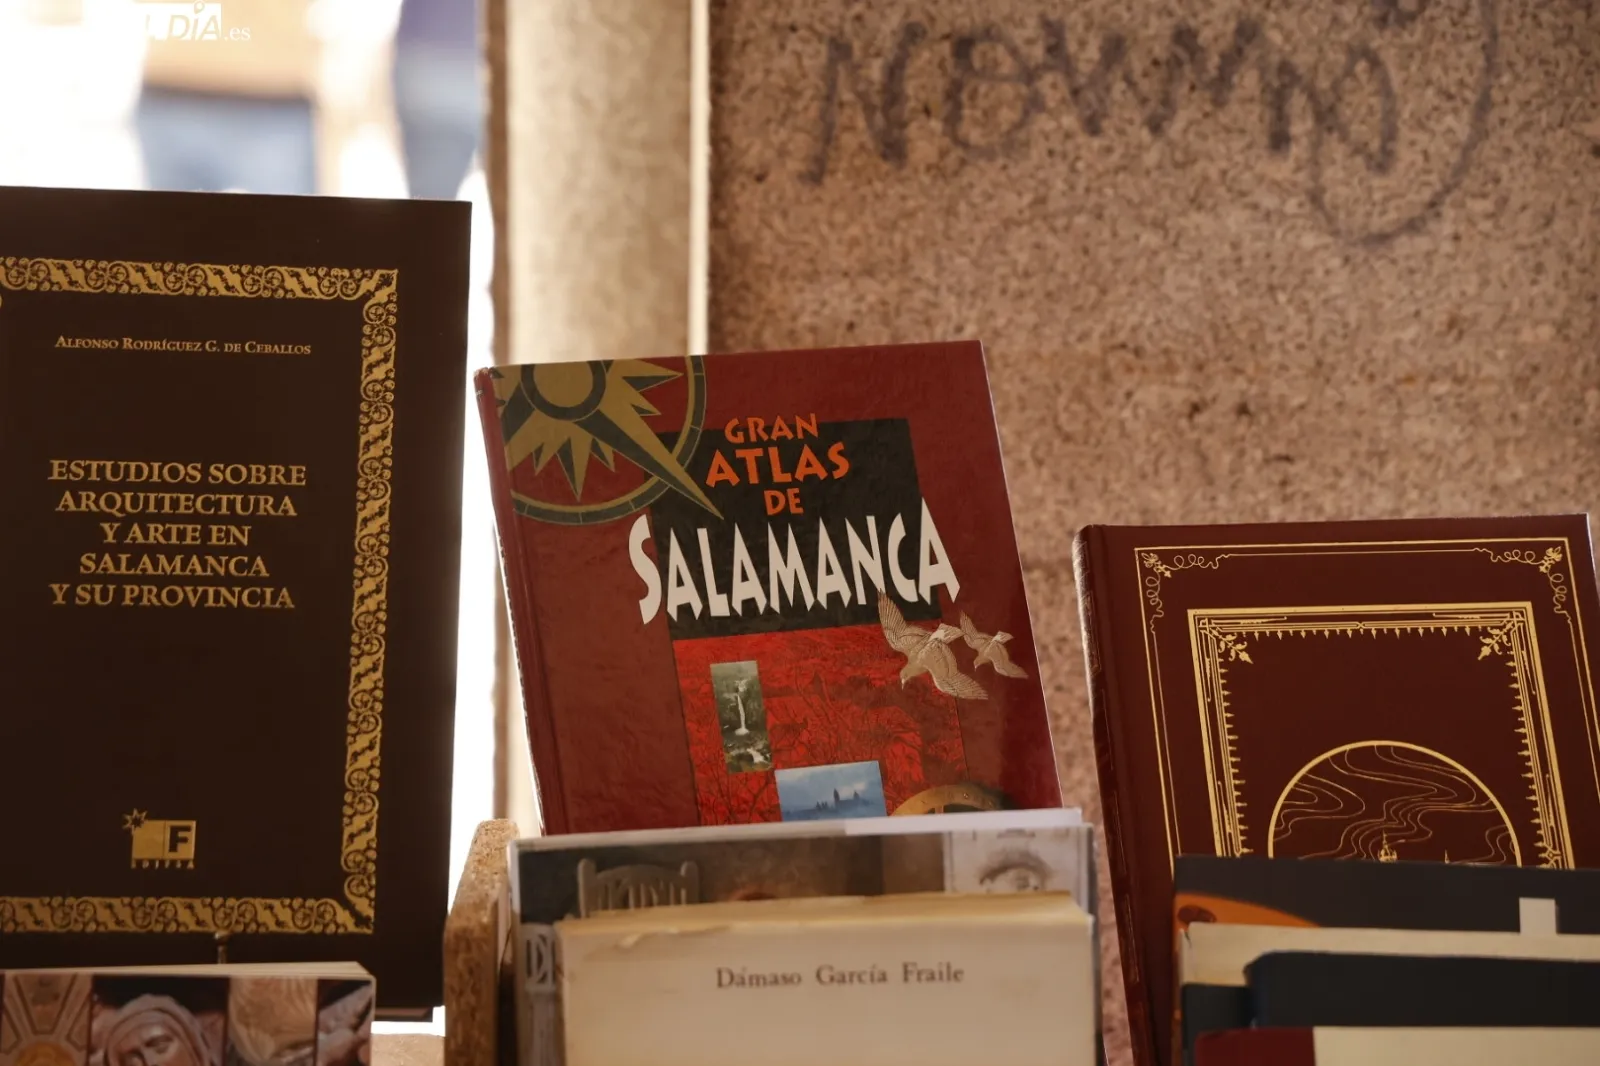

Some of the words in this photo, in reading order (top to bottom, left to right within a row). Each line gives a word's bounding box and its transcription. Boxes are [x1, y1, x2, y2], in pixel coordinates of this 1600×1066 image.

[204, 339, 221, 353] G.
[724, 413, 818, 443] GRAN
[48, 459, 202, 483] ESTUDIOS
[207, 463, 307, 485] SOBRE
[705, 441, 850, 488] ATLAS
[55, 490, 298, 517] ARQUITECTURA
[764, 487, 803, 515] DE
[100, 522, 121, 544] Y
[123, 522, 202, 545] ARTE
[206, 524, 252, 546] EN
[79, 552, 270, 577] SALAMANCA
[628, 497, 961, 625] SALAMANCA
[49, 583, 71, 605] Y
[75, 583, 117, 606] SU
[121, 584, 295, 609] PROVINCIA
[168, 825, 192, 852] F
[716, 966, 802, 988] Dámaso
[815, 963, 888, 986] García
[902, 961, 964, 984] Fraile
